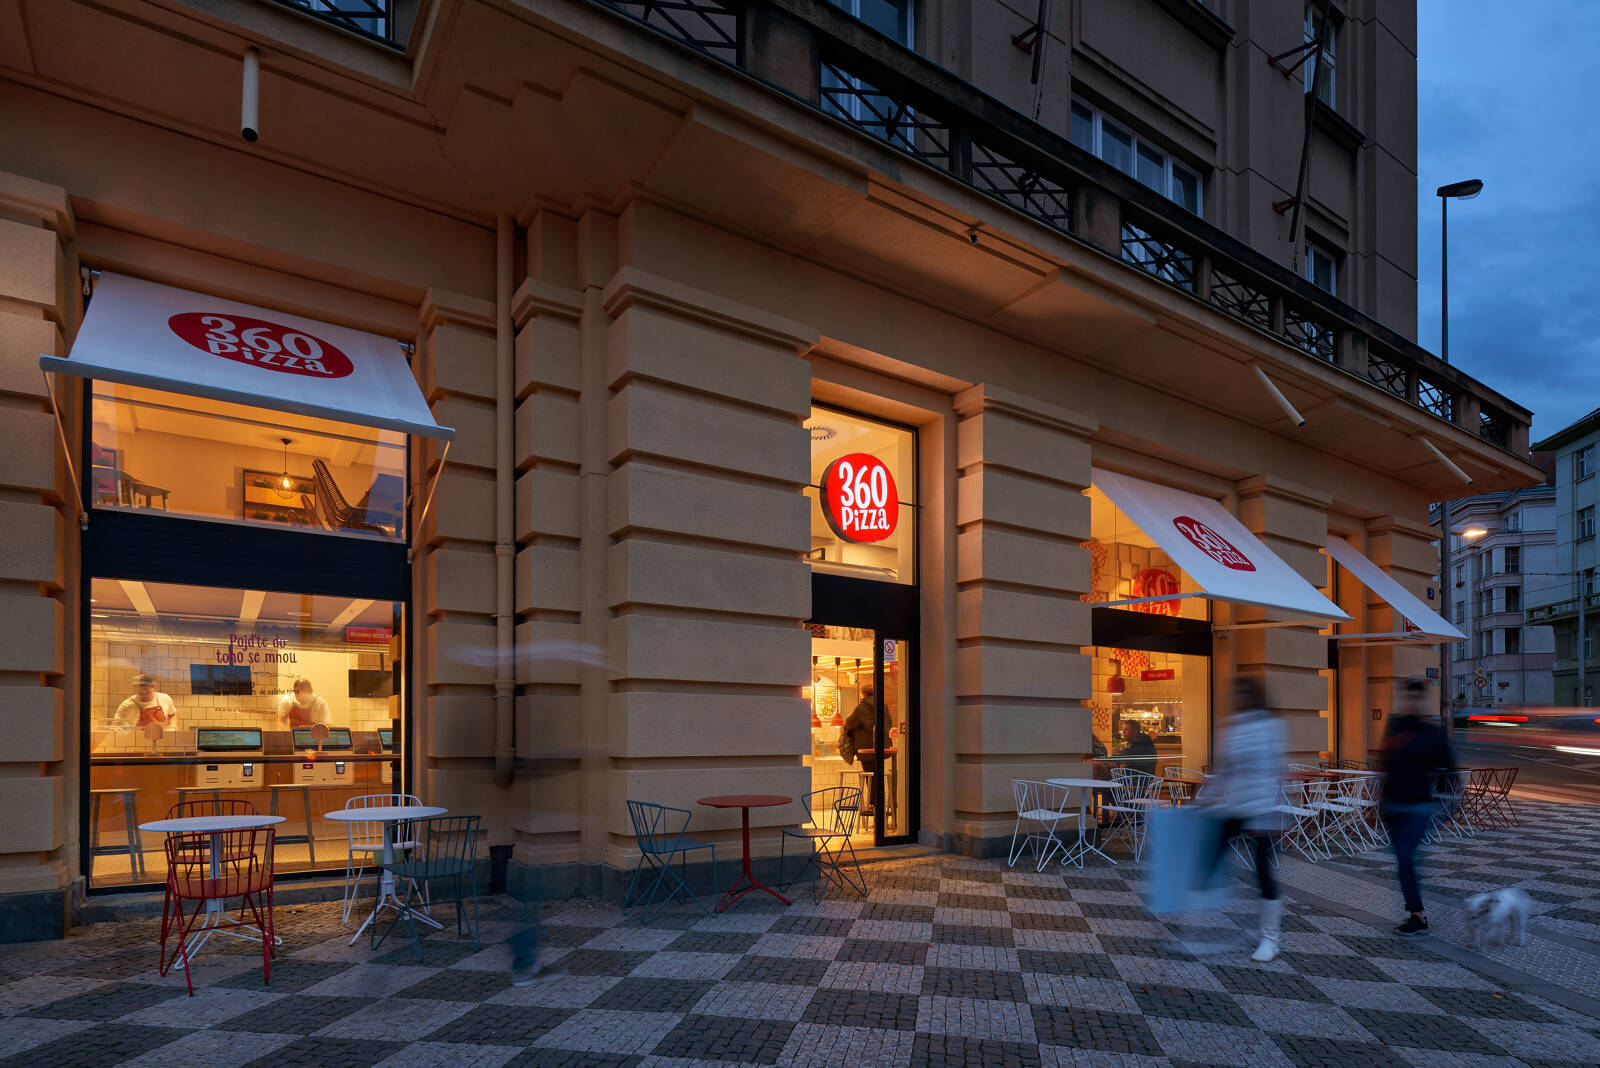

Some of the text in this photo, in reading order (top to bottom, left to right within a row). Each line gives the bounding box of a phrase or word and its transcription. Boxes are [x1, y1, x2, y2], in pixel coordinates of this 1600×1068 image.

[201, 316, 323, 360] 360
[207, 339, 334, 374] Pizza
[838, 461, 888, 509] 360
[841, 506, 890, 531] Pizza
[1177, 522, 1231, 551] 360
[272, 635, 286, 648] do
[216, 650, 297, 664] toho se mnou
